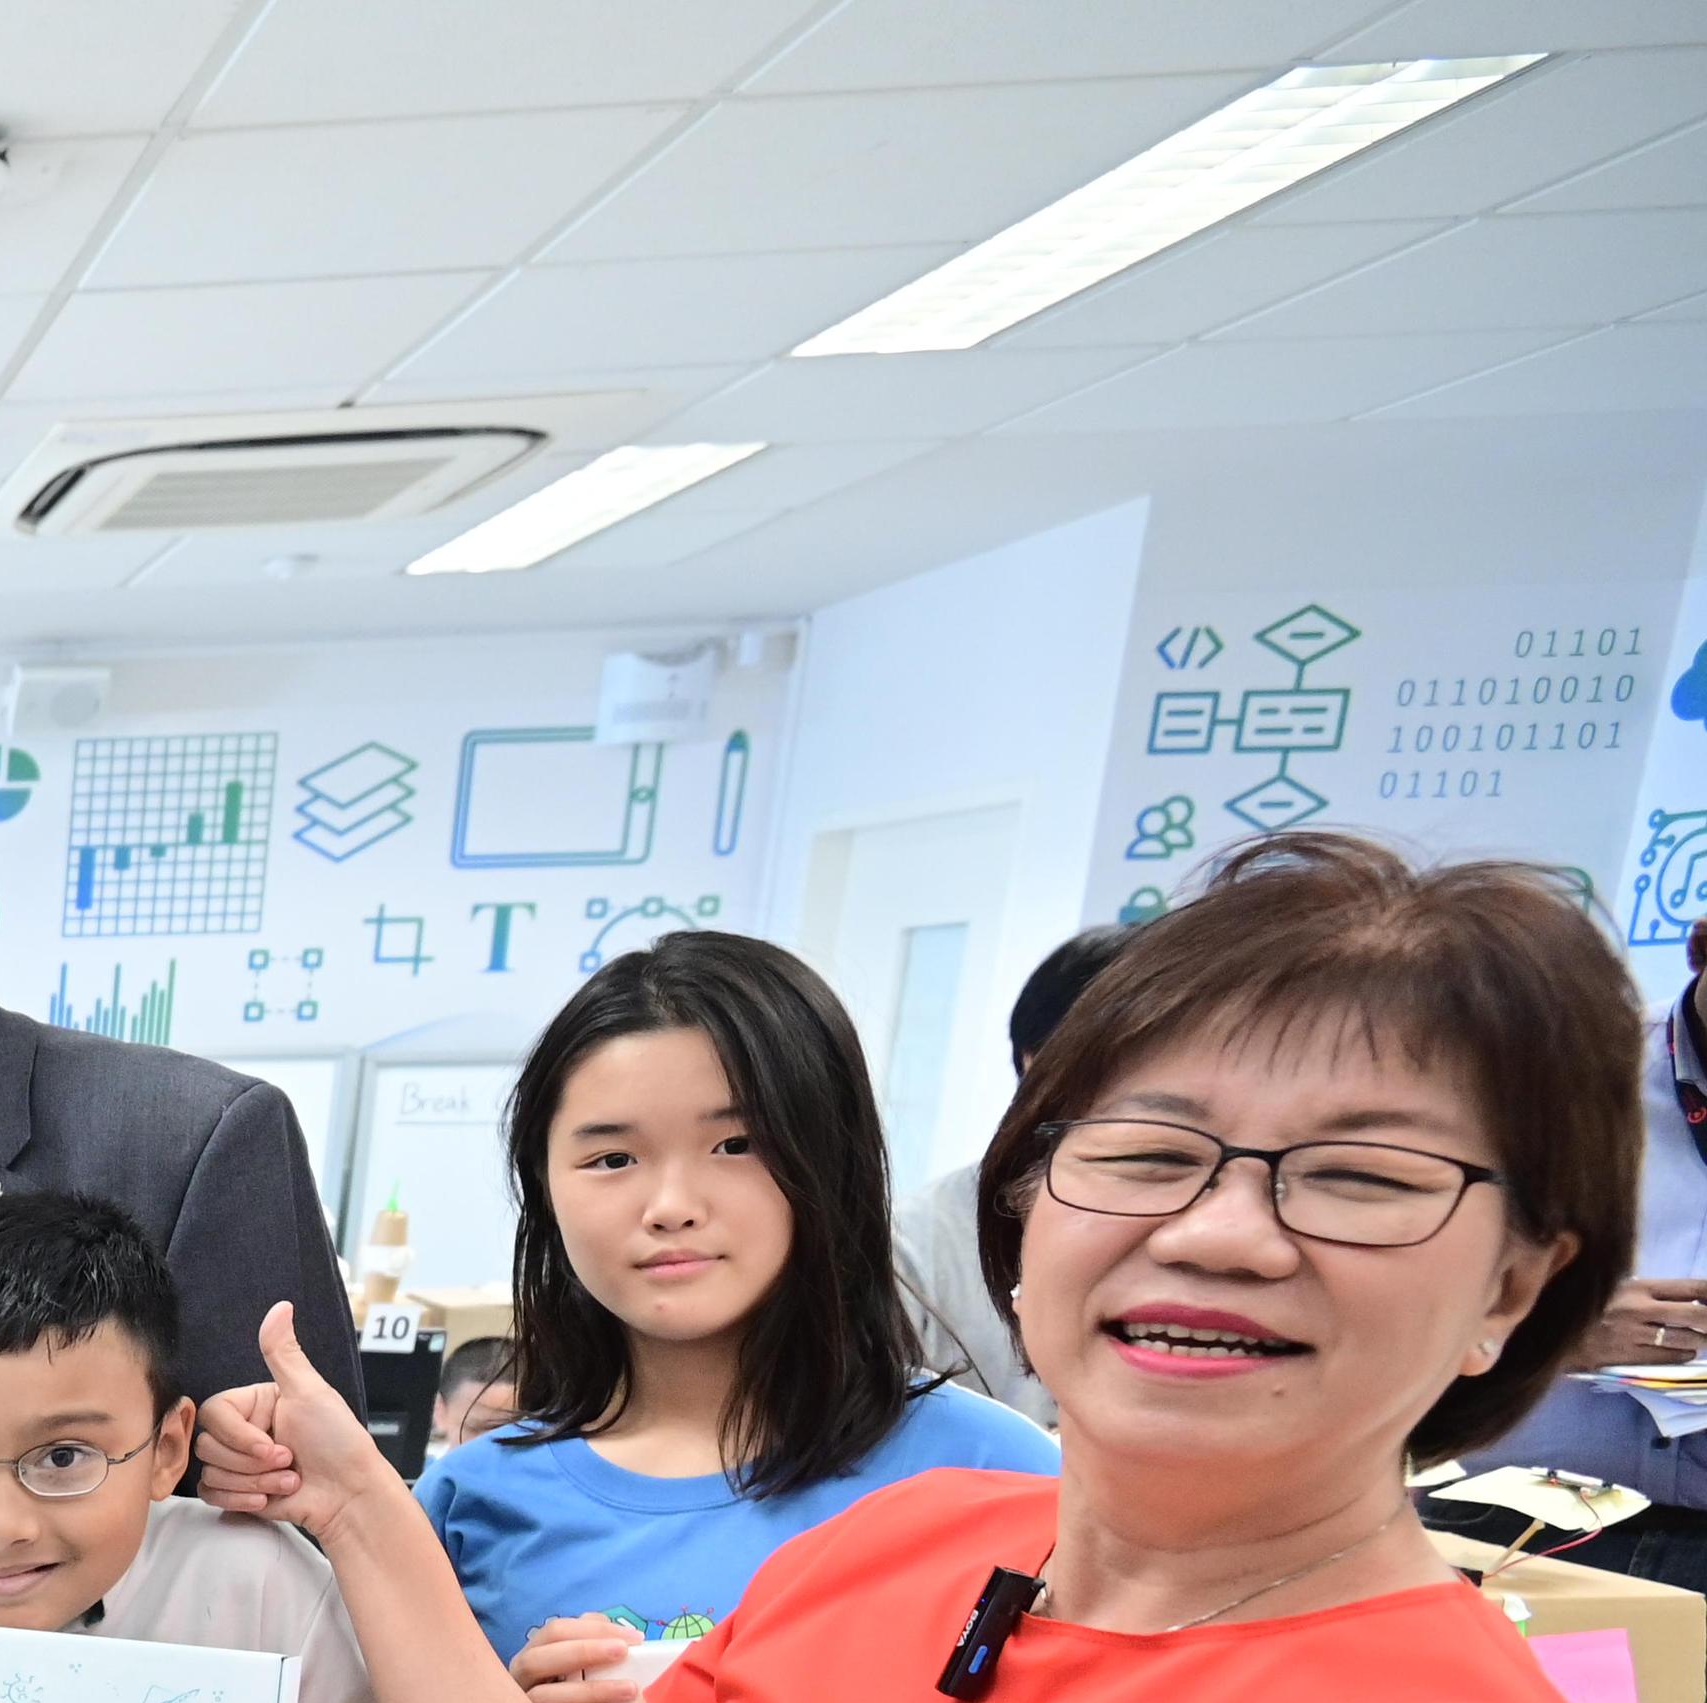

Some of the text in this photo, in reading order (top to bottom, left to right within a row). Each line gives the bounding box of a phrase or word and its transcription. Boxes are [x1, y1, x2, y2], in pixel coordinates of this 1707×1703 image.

[1514, 628, 1642, 659] 01101
[1396, 675, 1634, 709] 011010010
[1387, 721, 1622, 753] 100101101
[1379, 770, 1503, 800] 01101
[400, 1082, 471, 1115] Break
[371, 1315, 411, 1342] 10
